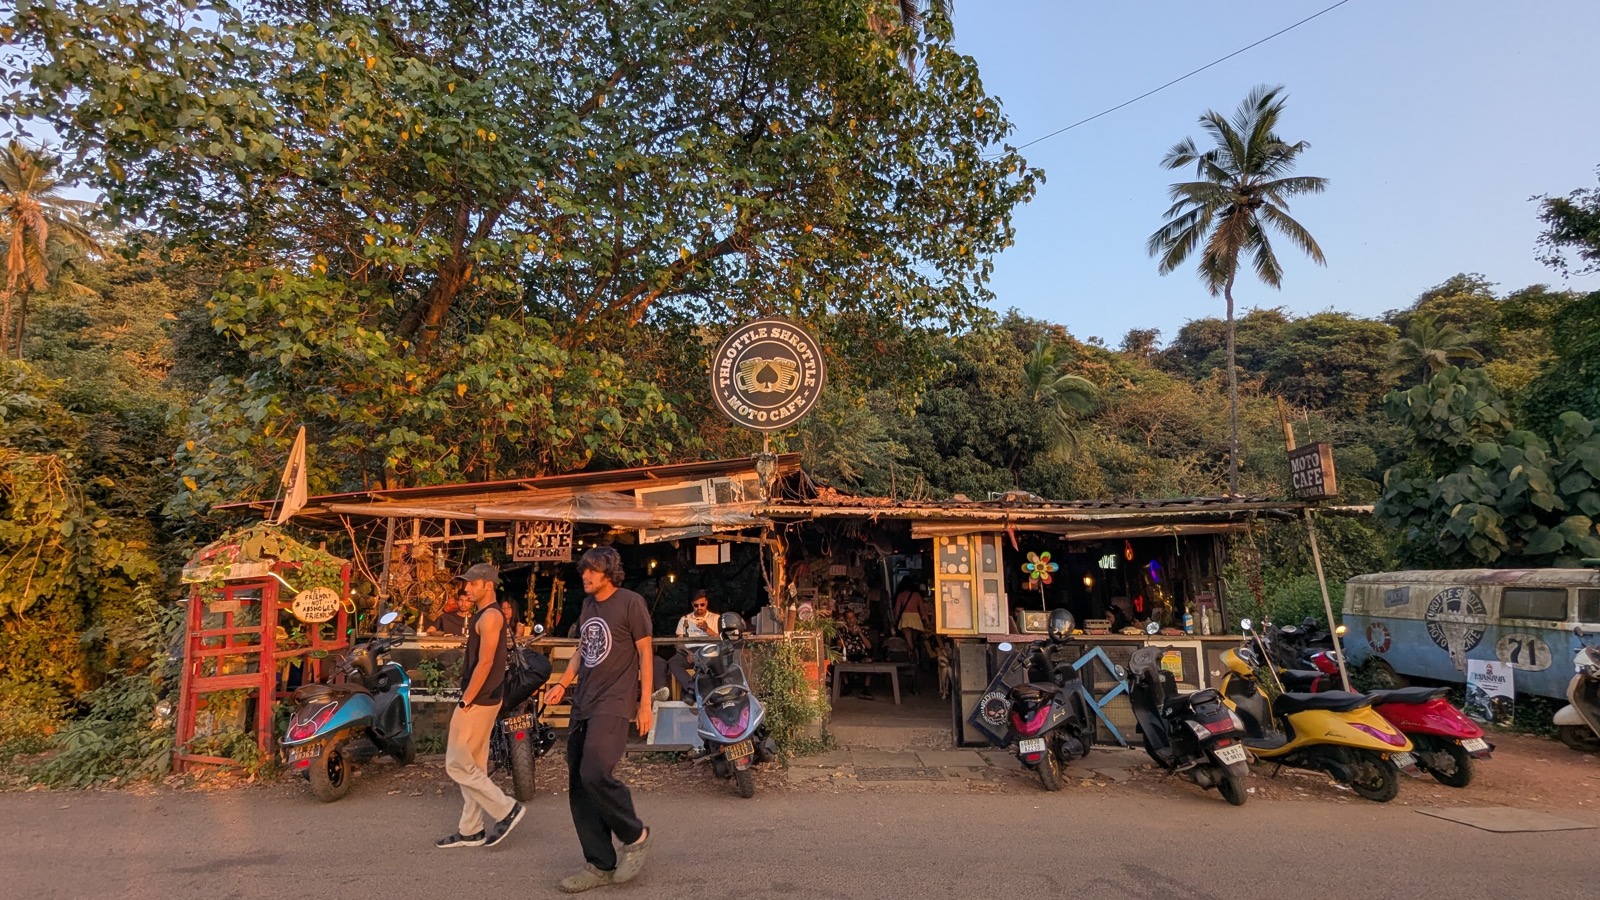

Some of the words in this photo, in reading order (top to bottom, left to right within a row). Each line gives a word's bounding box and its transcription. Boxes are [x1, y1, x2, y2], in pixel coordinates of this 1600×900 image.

[719, 327, 768, 388] THROTTLE
[770, 327, 817, 388] SHROTTLE
[726, 395, 767, 422] MOTO
[769, 395, 806, 421] CAFE
[1290, 452, 1320, 473] MOTO
[1292, 467, 1323, 489] CAFE
[518, 520, 571, 534] MOTO
[517, 533, 571, 549] CAFE
[1428, 624, 1447, 648] MOTO
[1507, 637, 1537, 666] 71
